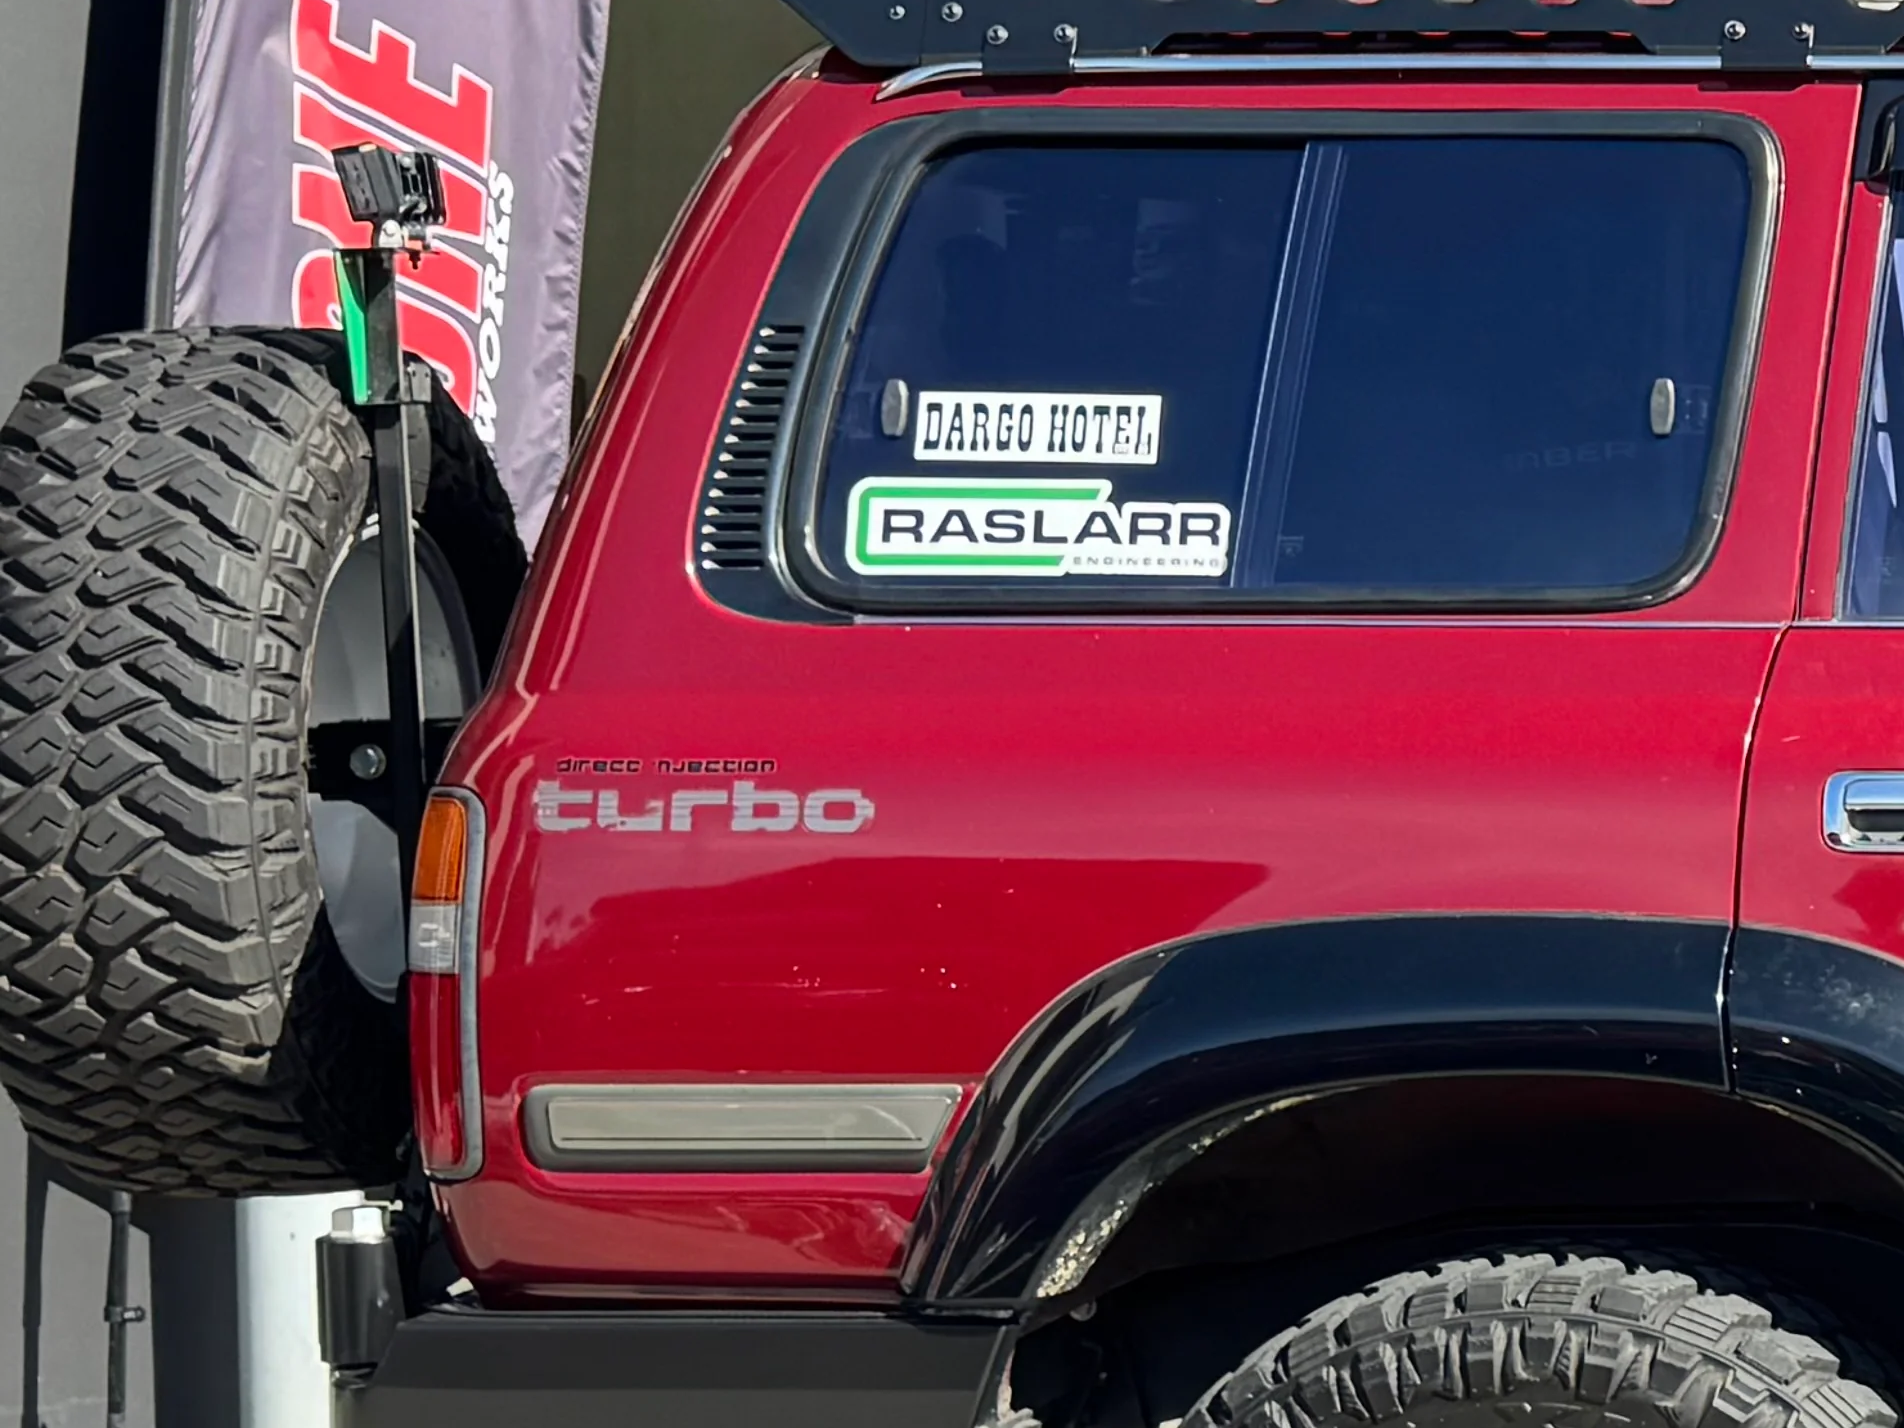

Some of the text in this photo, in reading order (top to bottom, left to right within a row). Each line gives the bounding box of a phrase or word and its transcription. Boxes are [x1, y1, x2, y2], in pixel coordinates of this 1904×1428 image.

[473, 160, 516, 444] WORKS
[922, 402, 1153, 456] DARGO HOTEL
[881, 508, 1222, 546] RASLARR
[1072, 555, 1220, 568] ENGINEERING
[652, 759, 778, 774] njection
[533, 779, 877, 834] turbo
